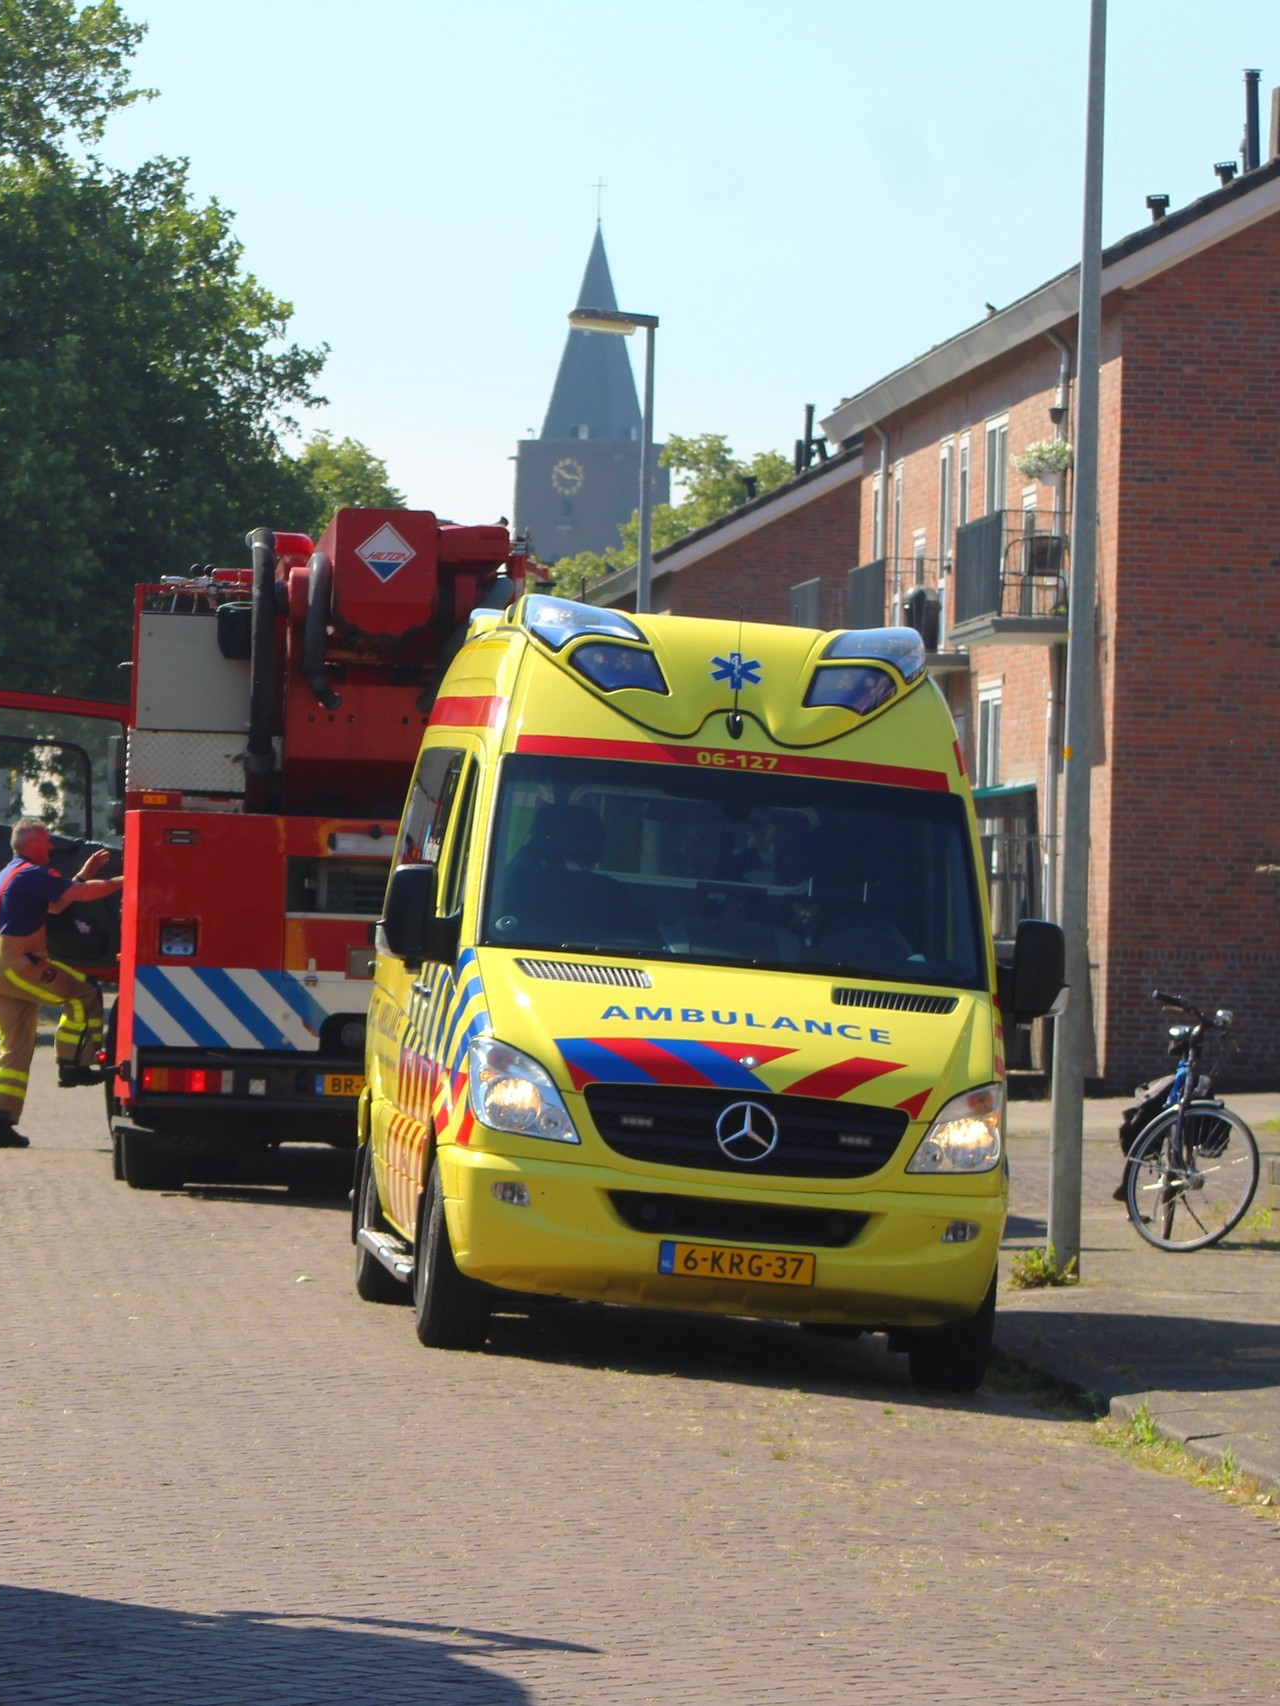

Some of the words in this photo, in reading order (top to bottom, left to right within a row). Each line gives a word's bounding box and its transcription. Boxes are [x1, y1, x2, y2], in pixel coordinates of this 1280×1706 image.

[697, 752, 778, 770] 06-127
[600, 1005, 892, 1045] AMBULANCE
[683, 1249, 804, 1280] 6-KRG-37
